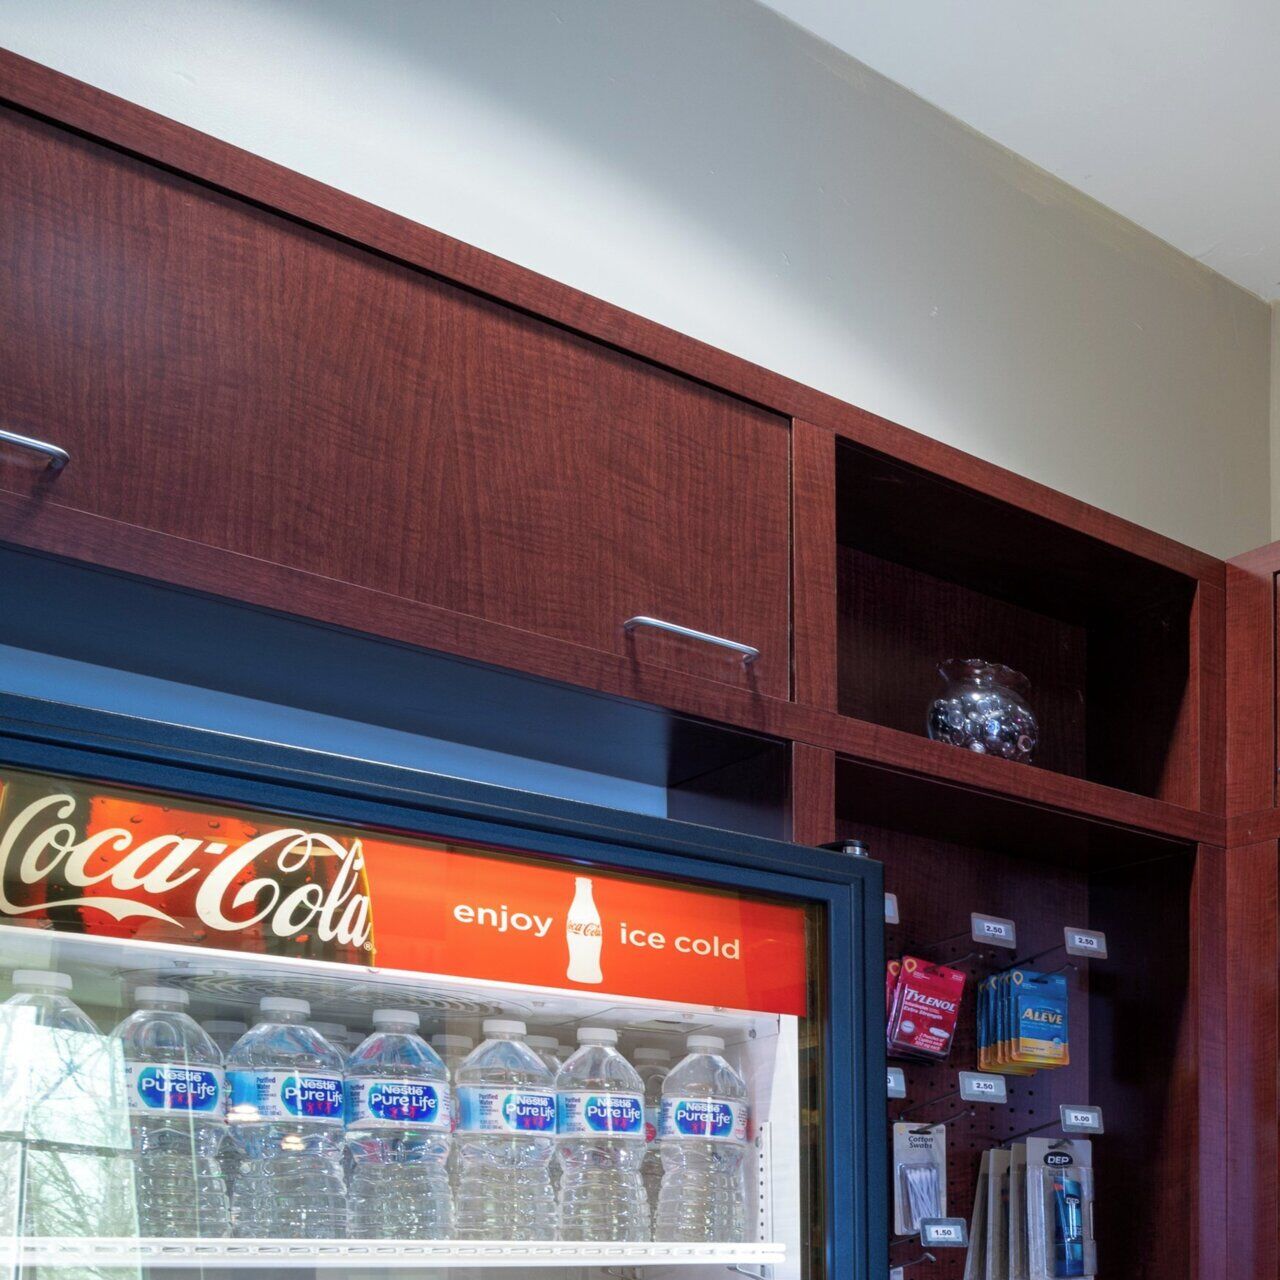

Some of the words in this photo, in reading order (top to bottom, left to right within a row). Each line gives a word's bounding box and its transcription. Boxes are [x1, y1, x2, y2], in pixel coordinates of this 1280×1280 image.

[0, 792, 374, 952] Coca-Cola
[454, 901, 553, 938] enjoy
[620, 921, 667, 950] ice
[674, 928, 741, 961] cold
[986, 926, 1002, 934] 2.50
[906, 989, 957, 1012] TYLENOL
[1022, 1008, 1063, 1024] ALEVE
[371, 1093, 410, 1106] Pure
[413, 1095, 435, 1109] Life
[587, 1107, 621, 1117] Pure
[623, 1108, 641, 1121] Life
[677, 1110, 708, 1121] Pure
[710, 1113, 731, 1126] Life
[1048, 1156, 1069, 1164] DEP
